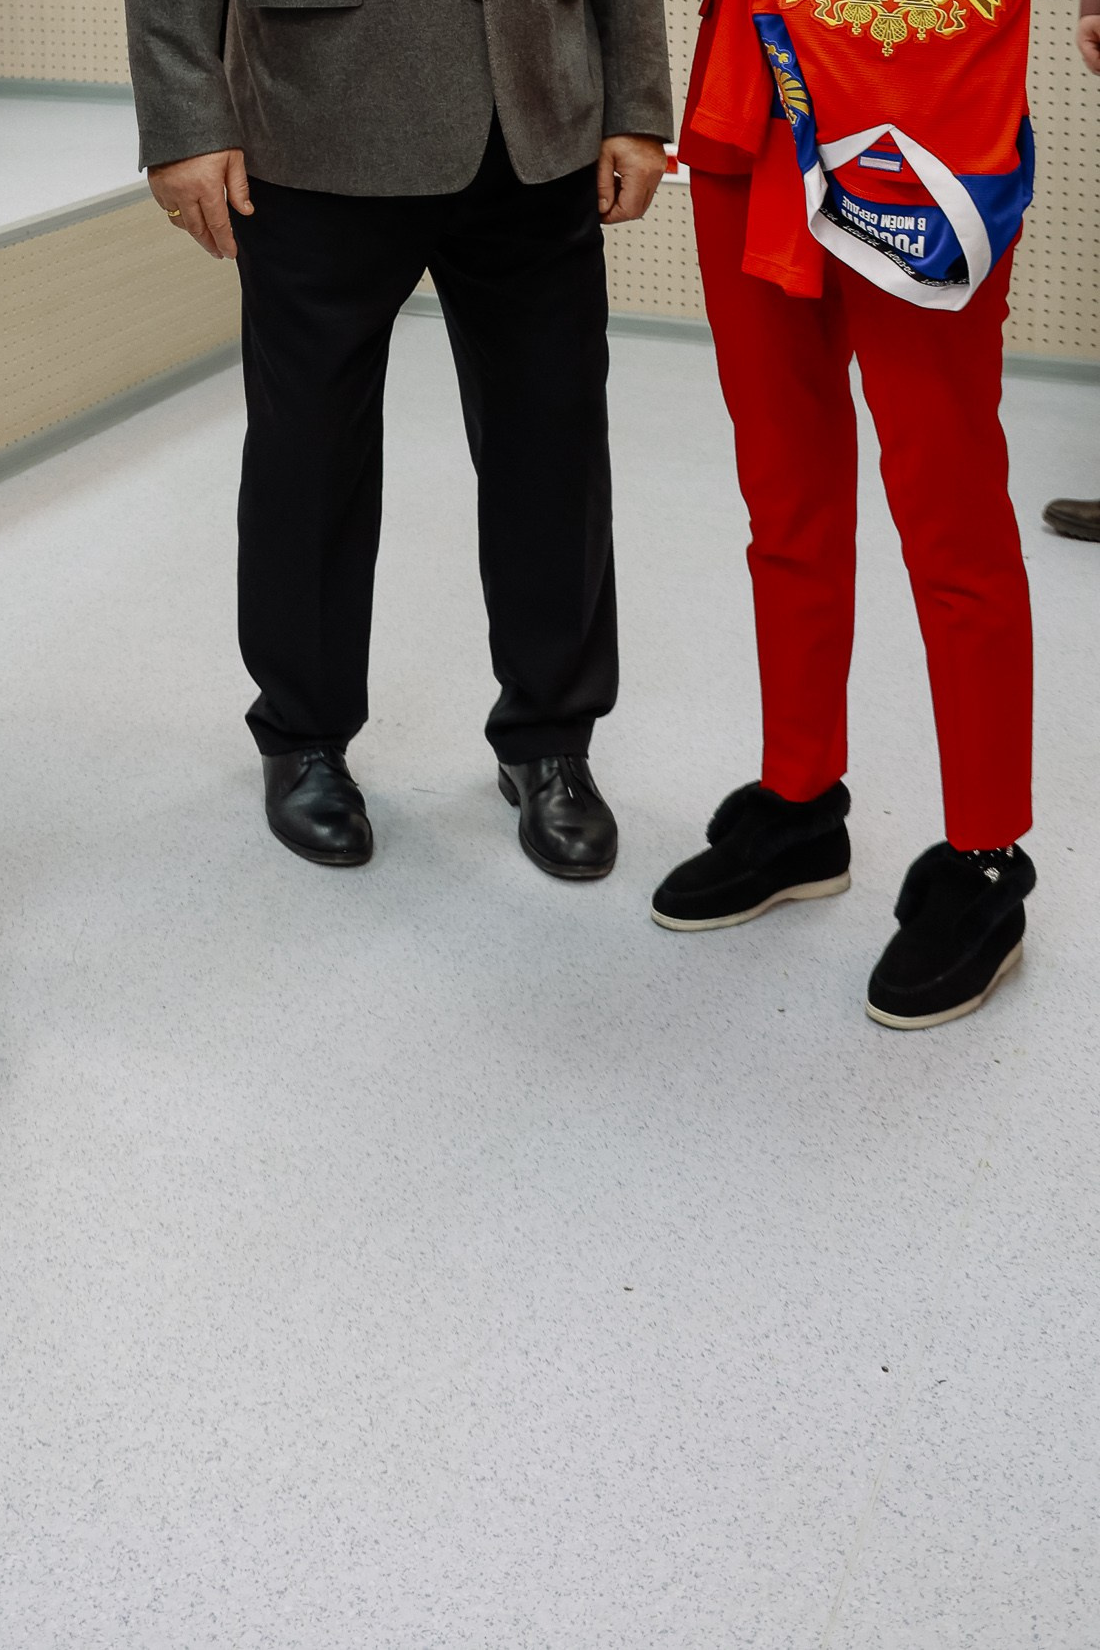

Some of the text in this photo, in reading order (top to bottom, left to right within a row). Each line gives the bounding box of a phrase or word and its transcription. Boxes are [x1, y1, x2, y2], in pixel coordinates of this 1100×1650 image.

[842, 195, 927, 232] В МОЁМ СЕРДЦЕ
[884, 250, 916, 276] РО-СПОРТ
